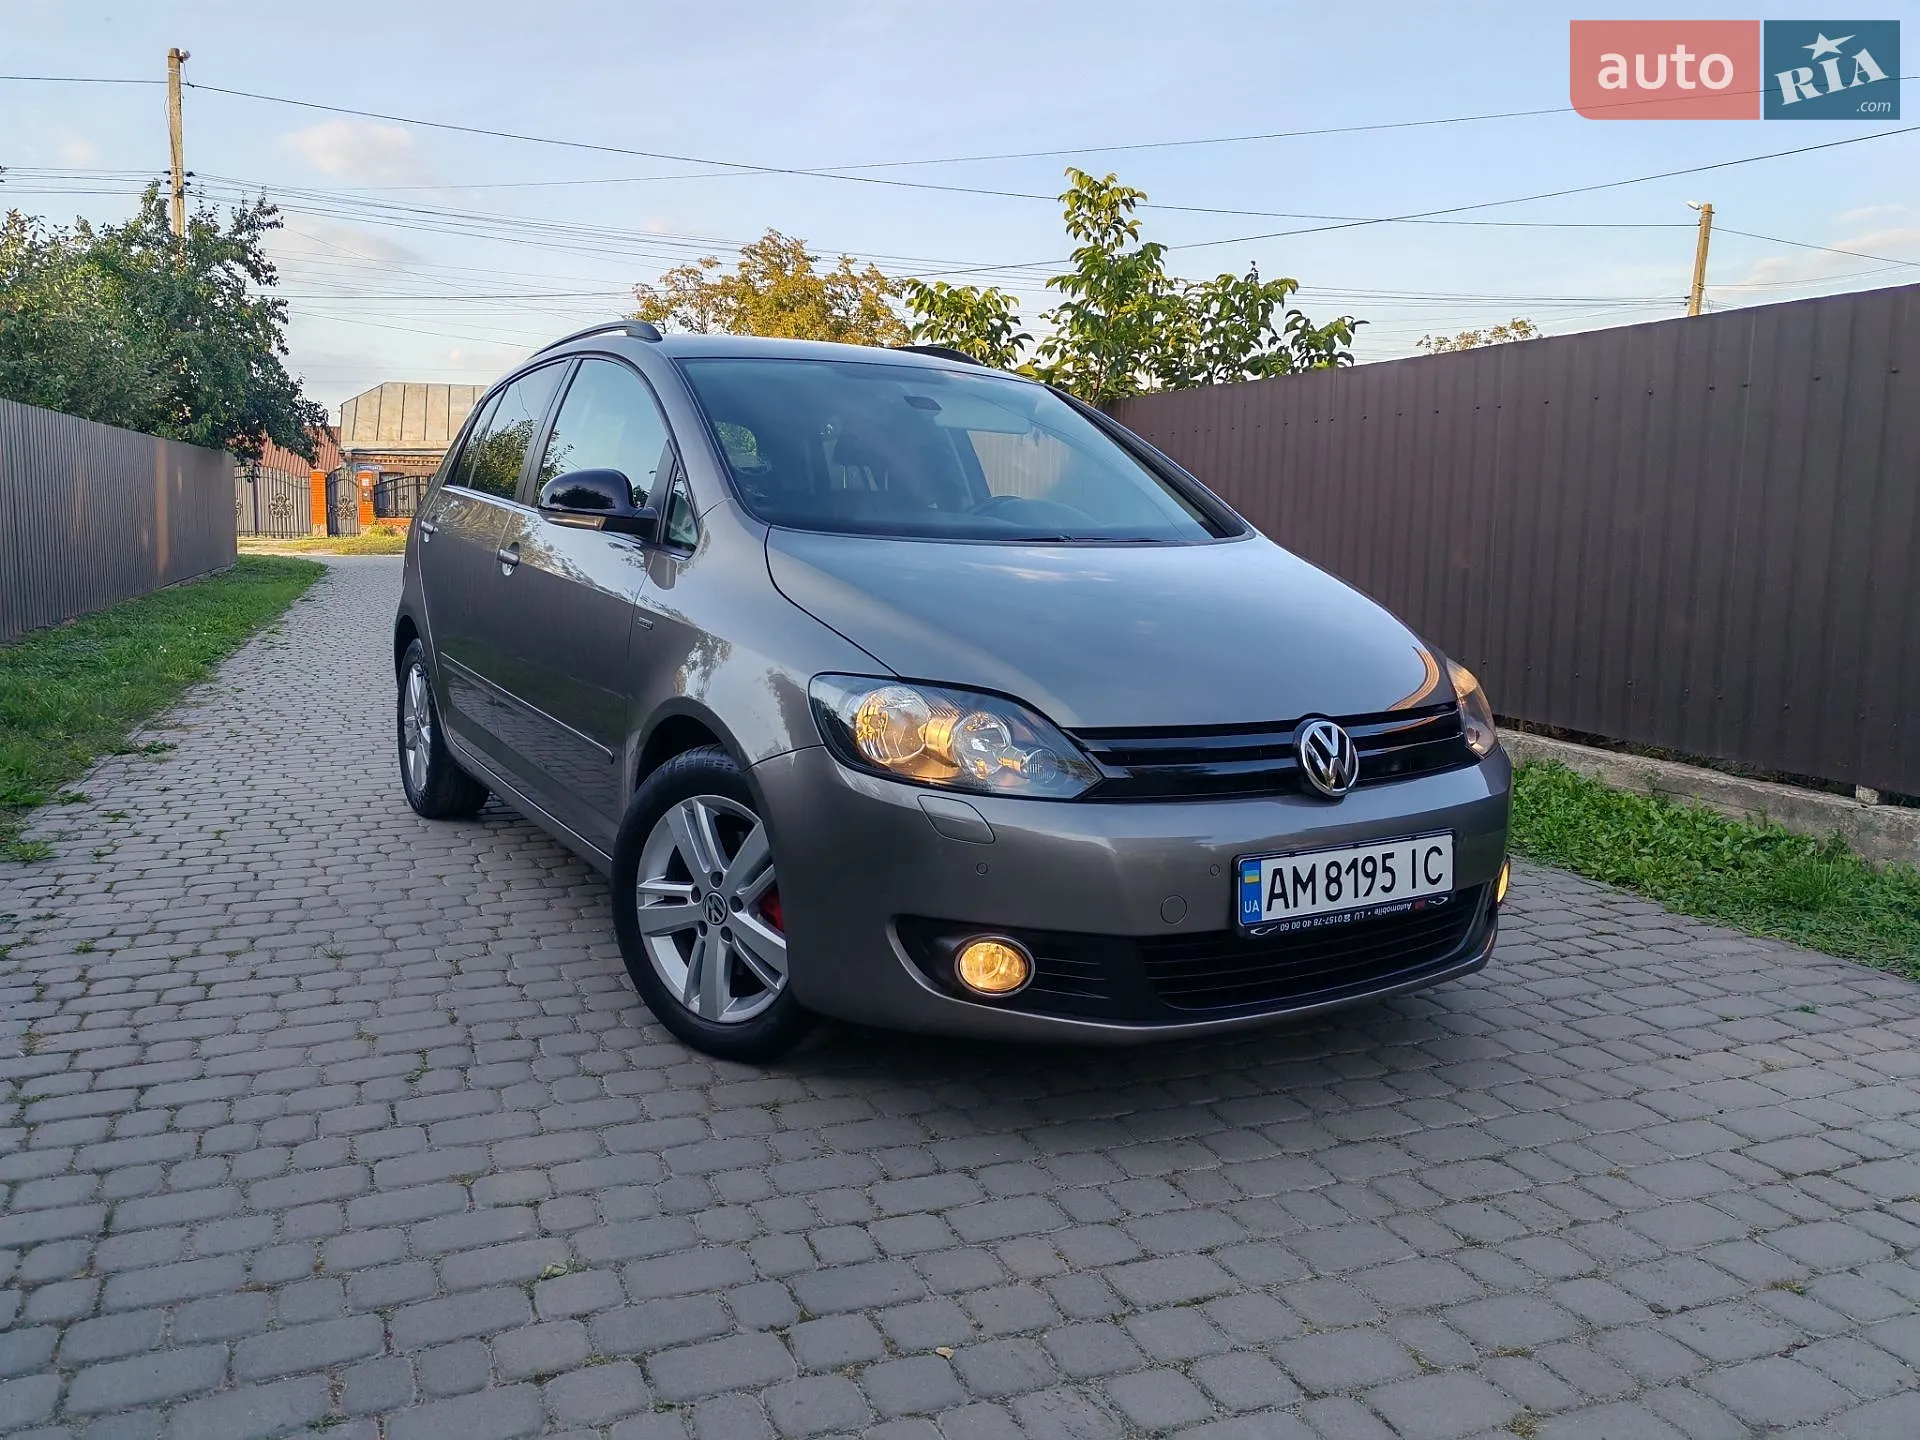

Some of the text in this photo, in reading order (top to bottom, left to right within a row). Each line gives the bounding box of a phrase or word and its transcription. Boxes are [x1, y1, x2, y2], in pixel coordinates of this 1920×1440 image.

[1411, 845, 1444, 889] IC
[1244, 900, 1260, 913] UA
[1374, 902, 1412, 916] Automobile
